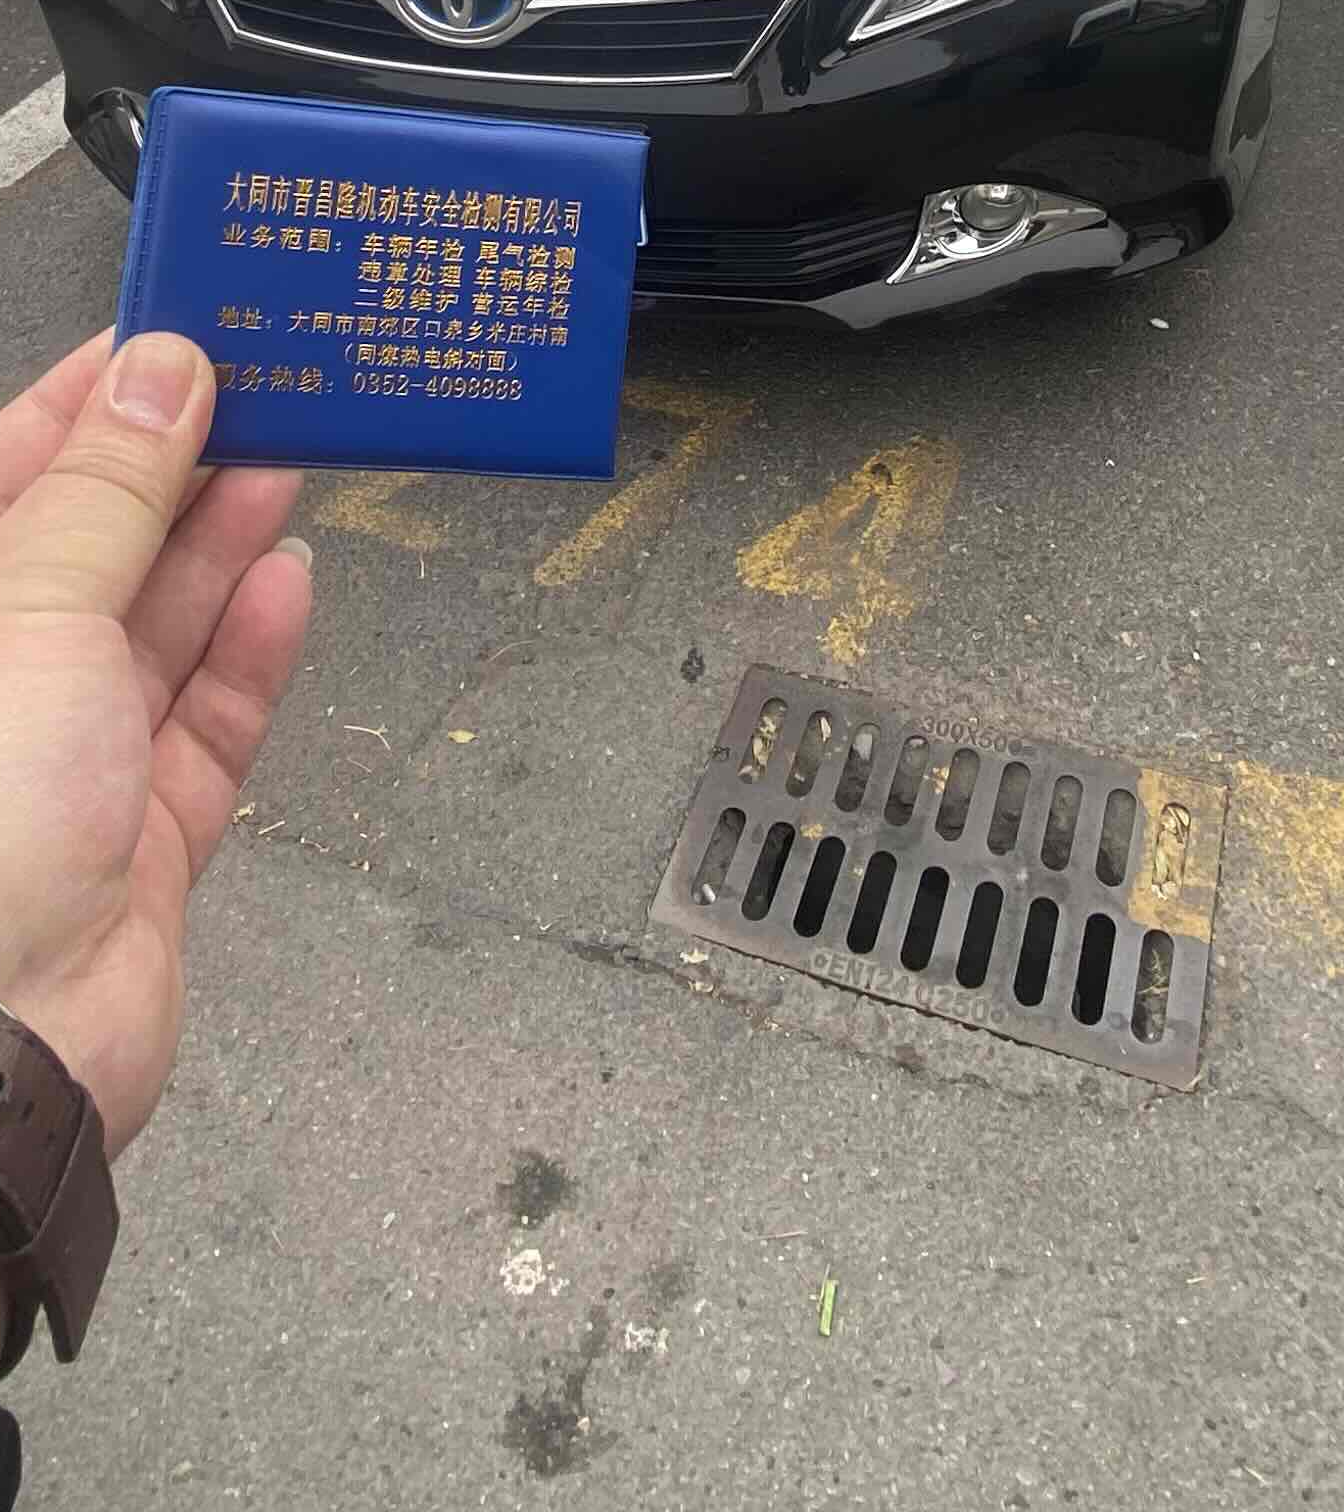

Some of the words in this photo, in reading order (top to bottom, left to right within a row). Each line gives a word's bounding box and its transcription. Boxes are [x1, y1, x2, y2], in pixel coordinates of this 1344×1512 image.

[360, 232, 465, 263] 车辆年检
[475, 240, 576, 270] 尾气检测
[358, 261, 462, 288] 违章处理
[353, 286, 459, 314] 二级维护
[471, 292, 570, 320] 营运年检
